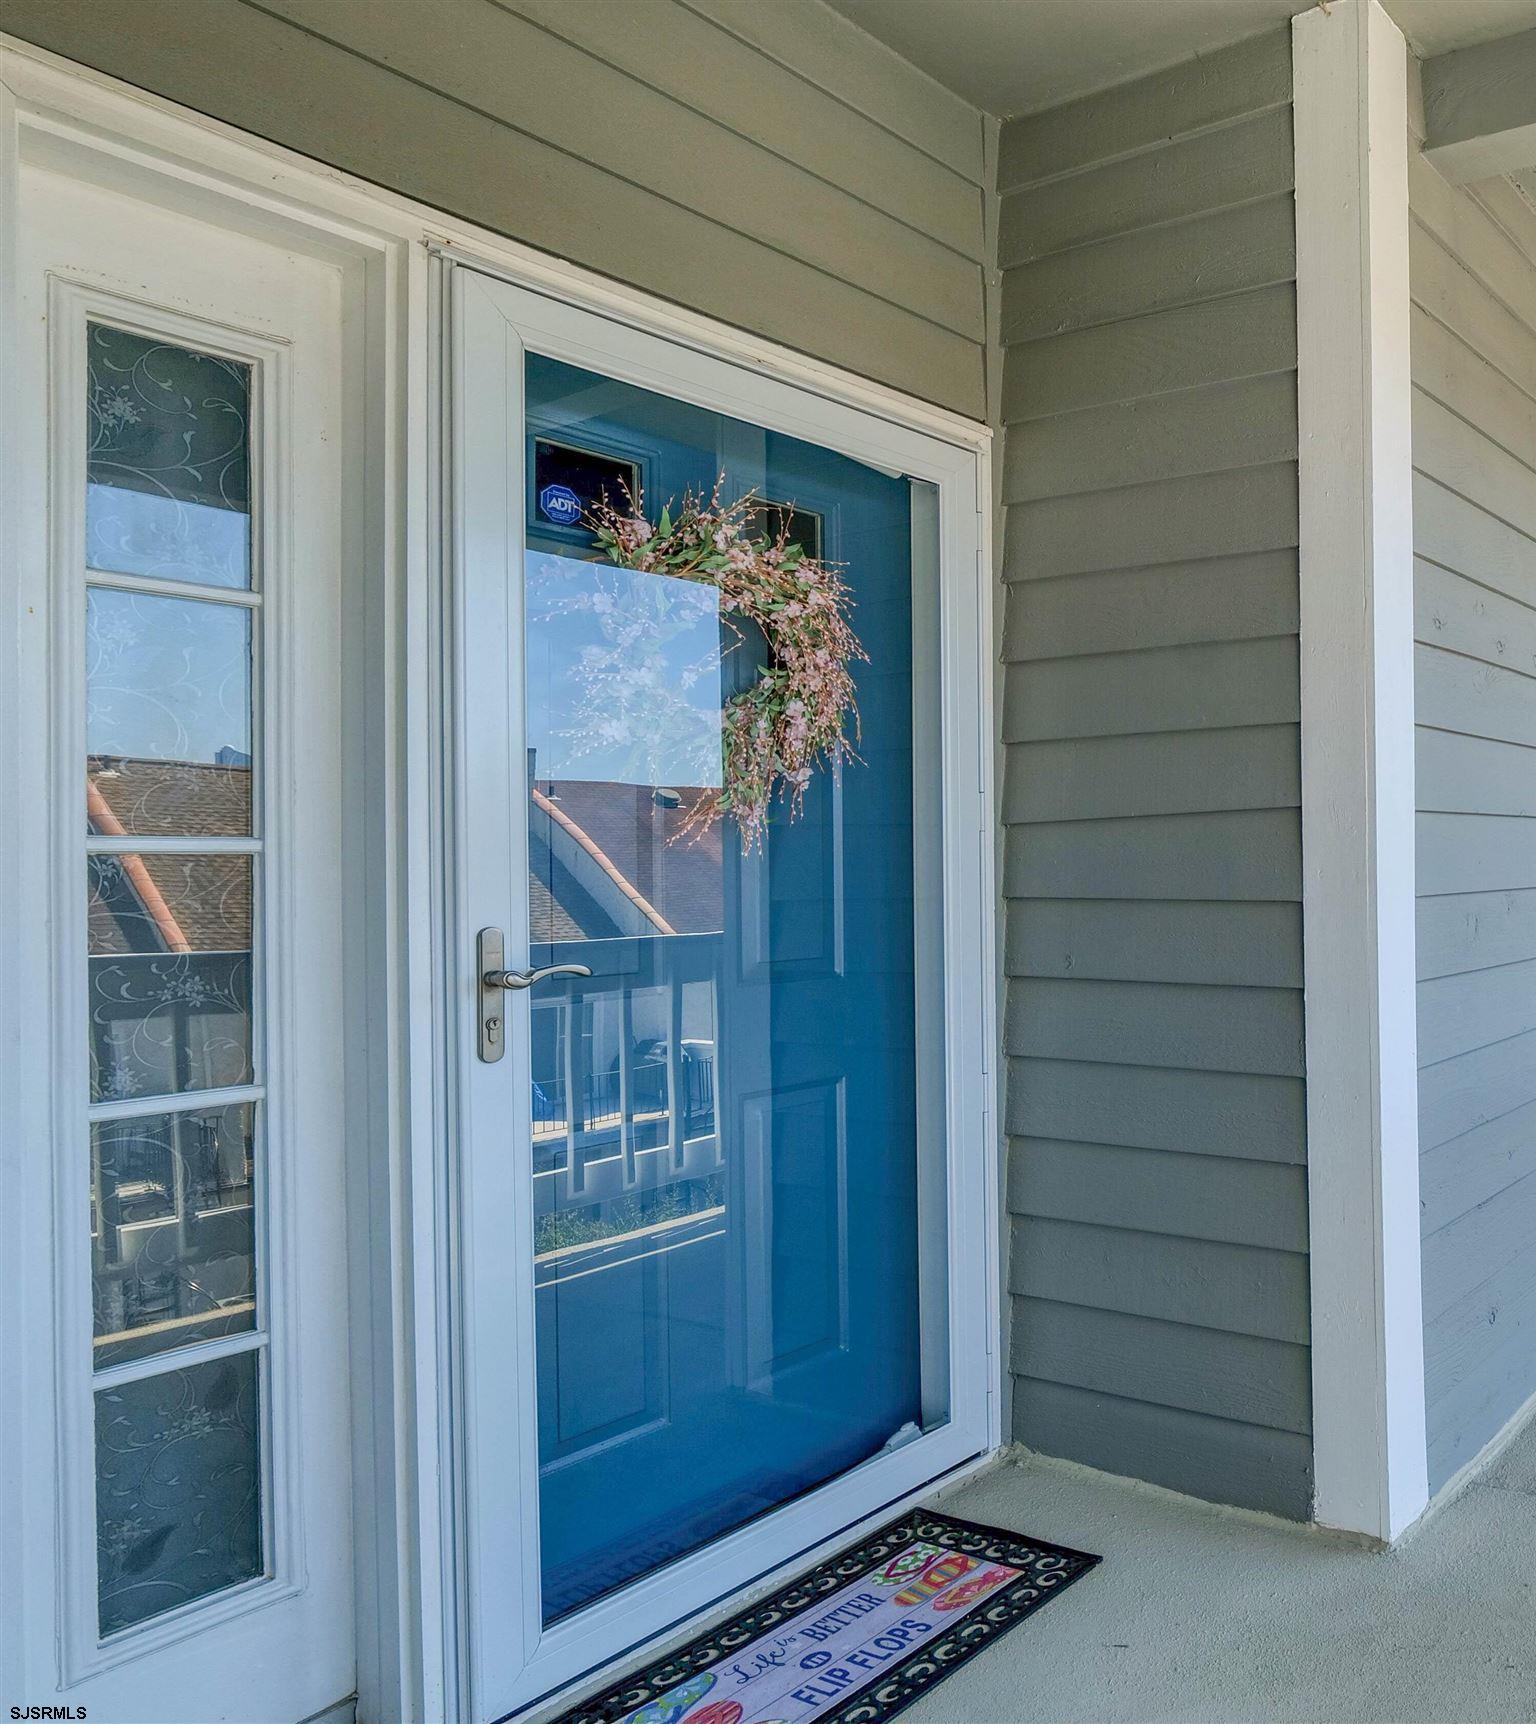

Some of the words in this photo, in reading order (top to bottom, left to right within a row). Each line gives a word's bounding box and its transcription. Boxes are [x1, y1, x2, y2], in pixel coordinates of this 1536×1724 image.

[548, 497, 574, 513] ADT
[724, 1647, 785, 1684] Life
[798, 1593, 886, 1642] BETTER
[790, 1667, 854, 1706] FLIP
[845, 1619, 932, 1669] FLOPS
